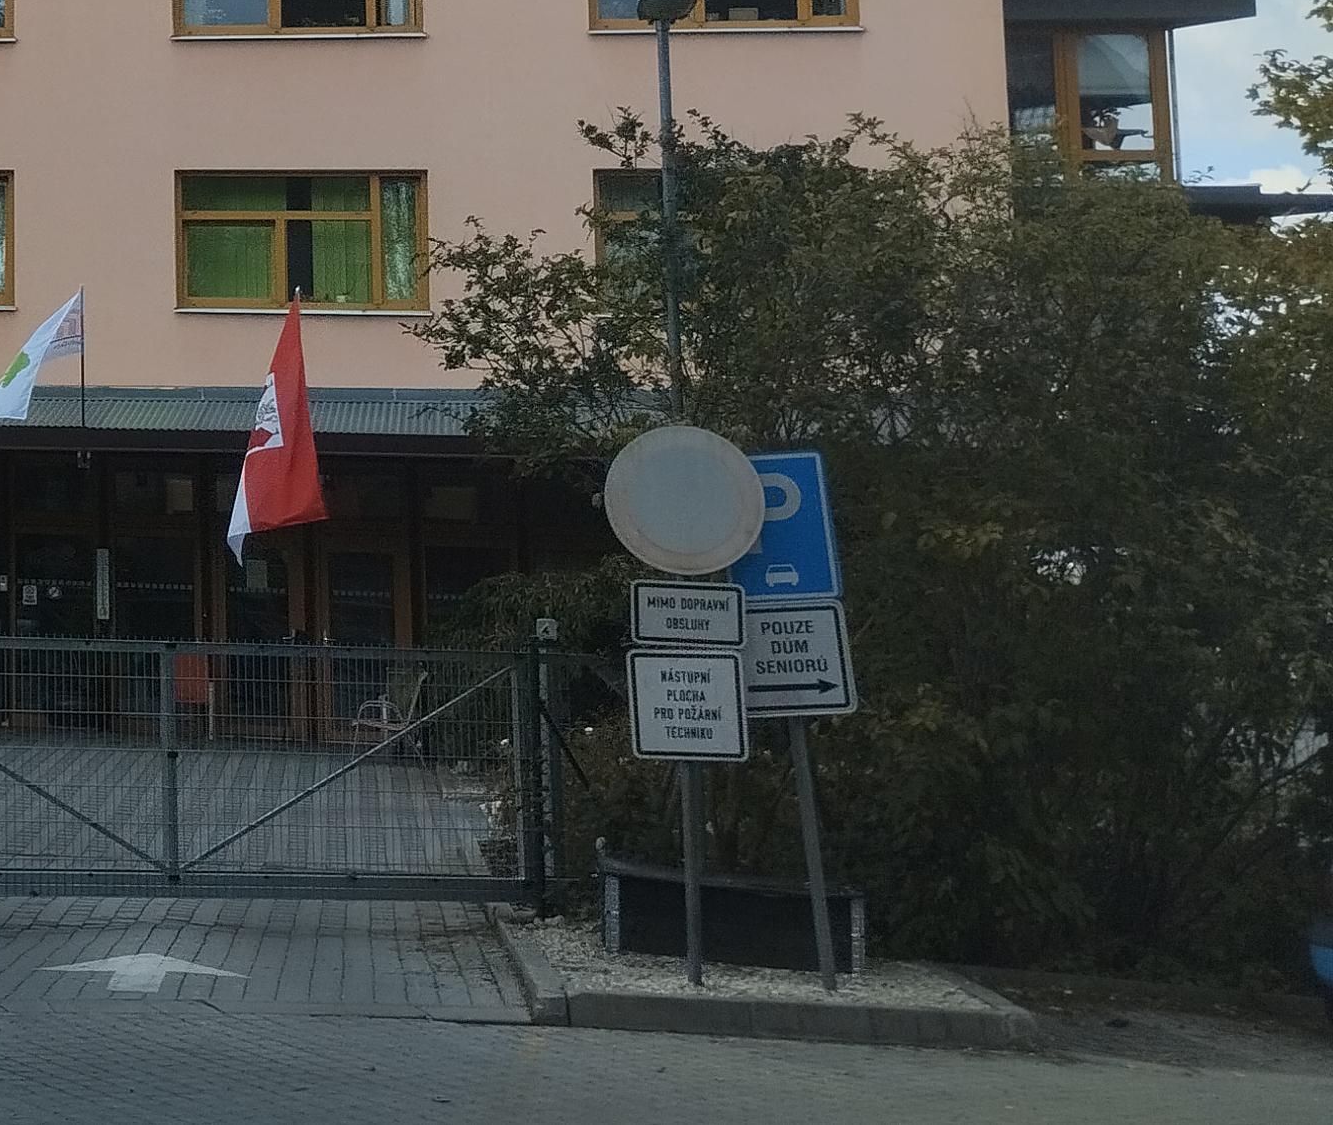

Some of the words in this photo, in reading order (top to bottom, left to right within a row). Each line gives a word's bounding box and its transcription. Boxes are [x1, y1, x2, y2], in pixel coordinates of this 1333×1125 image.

[749, 472, 802, 554] P
[646, 596, 676, 609] MIMO
[680, 596, 731, 612] DOPRAVNÍ
[666, 617, 711, 631] OBSLUHY
[760, 620, 815, 635] POUZE
[755, 654, 829, 675] SENIORŮ
[660, 667, 711, 684] NÁSTUPNÍ
[666, 689, 706, 702] PLOCHA
[653, 706, 674, 720] PRO
[678, 704, 722, 721] POŽÁRNÍ
[664, 725, 714, 740] TECHNIKU
